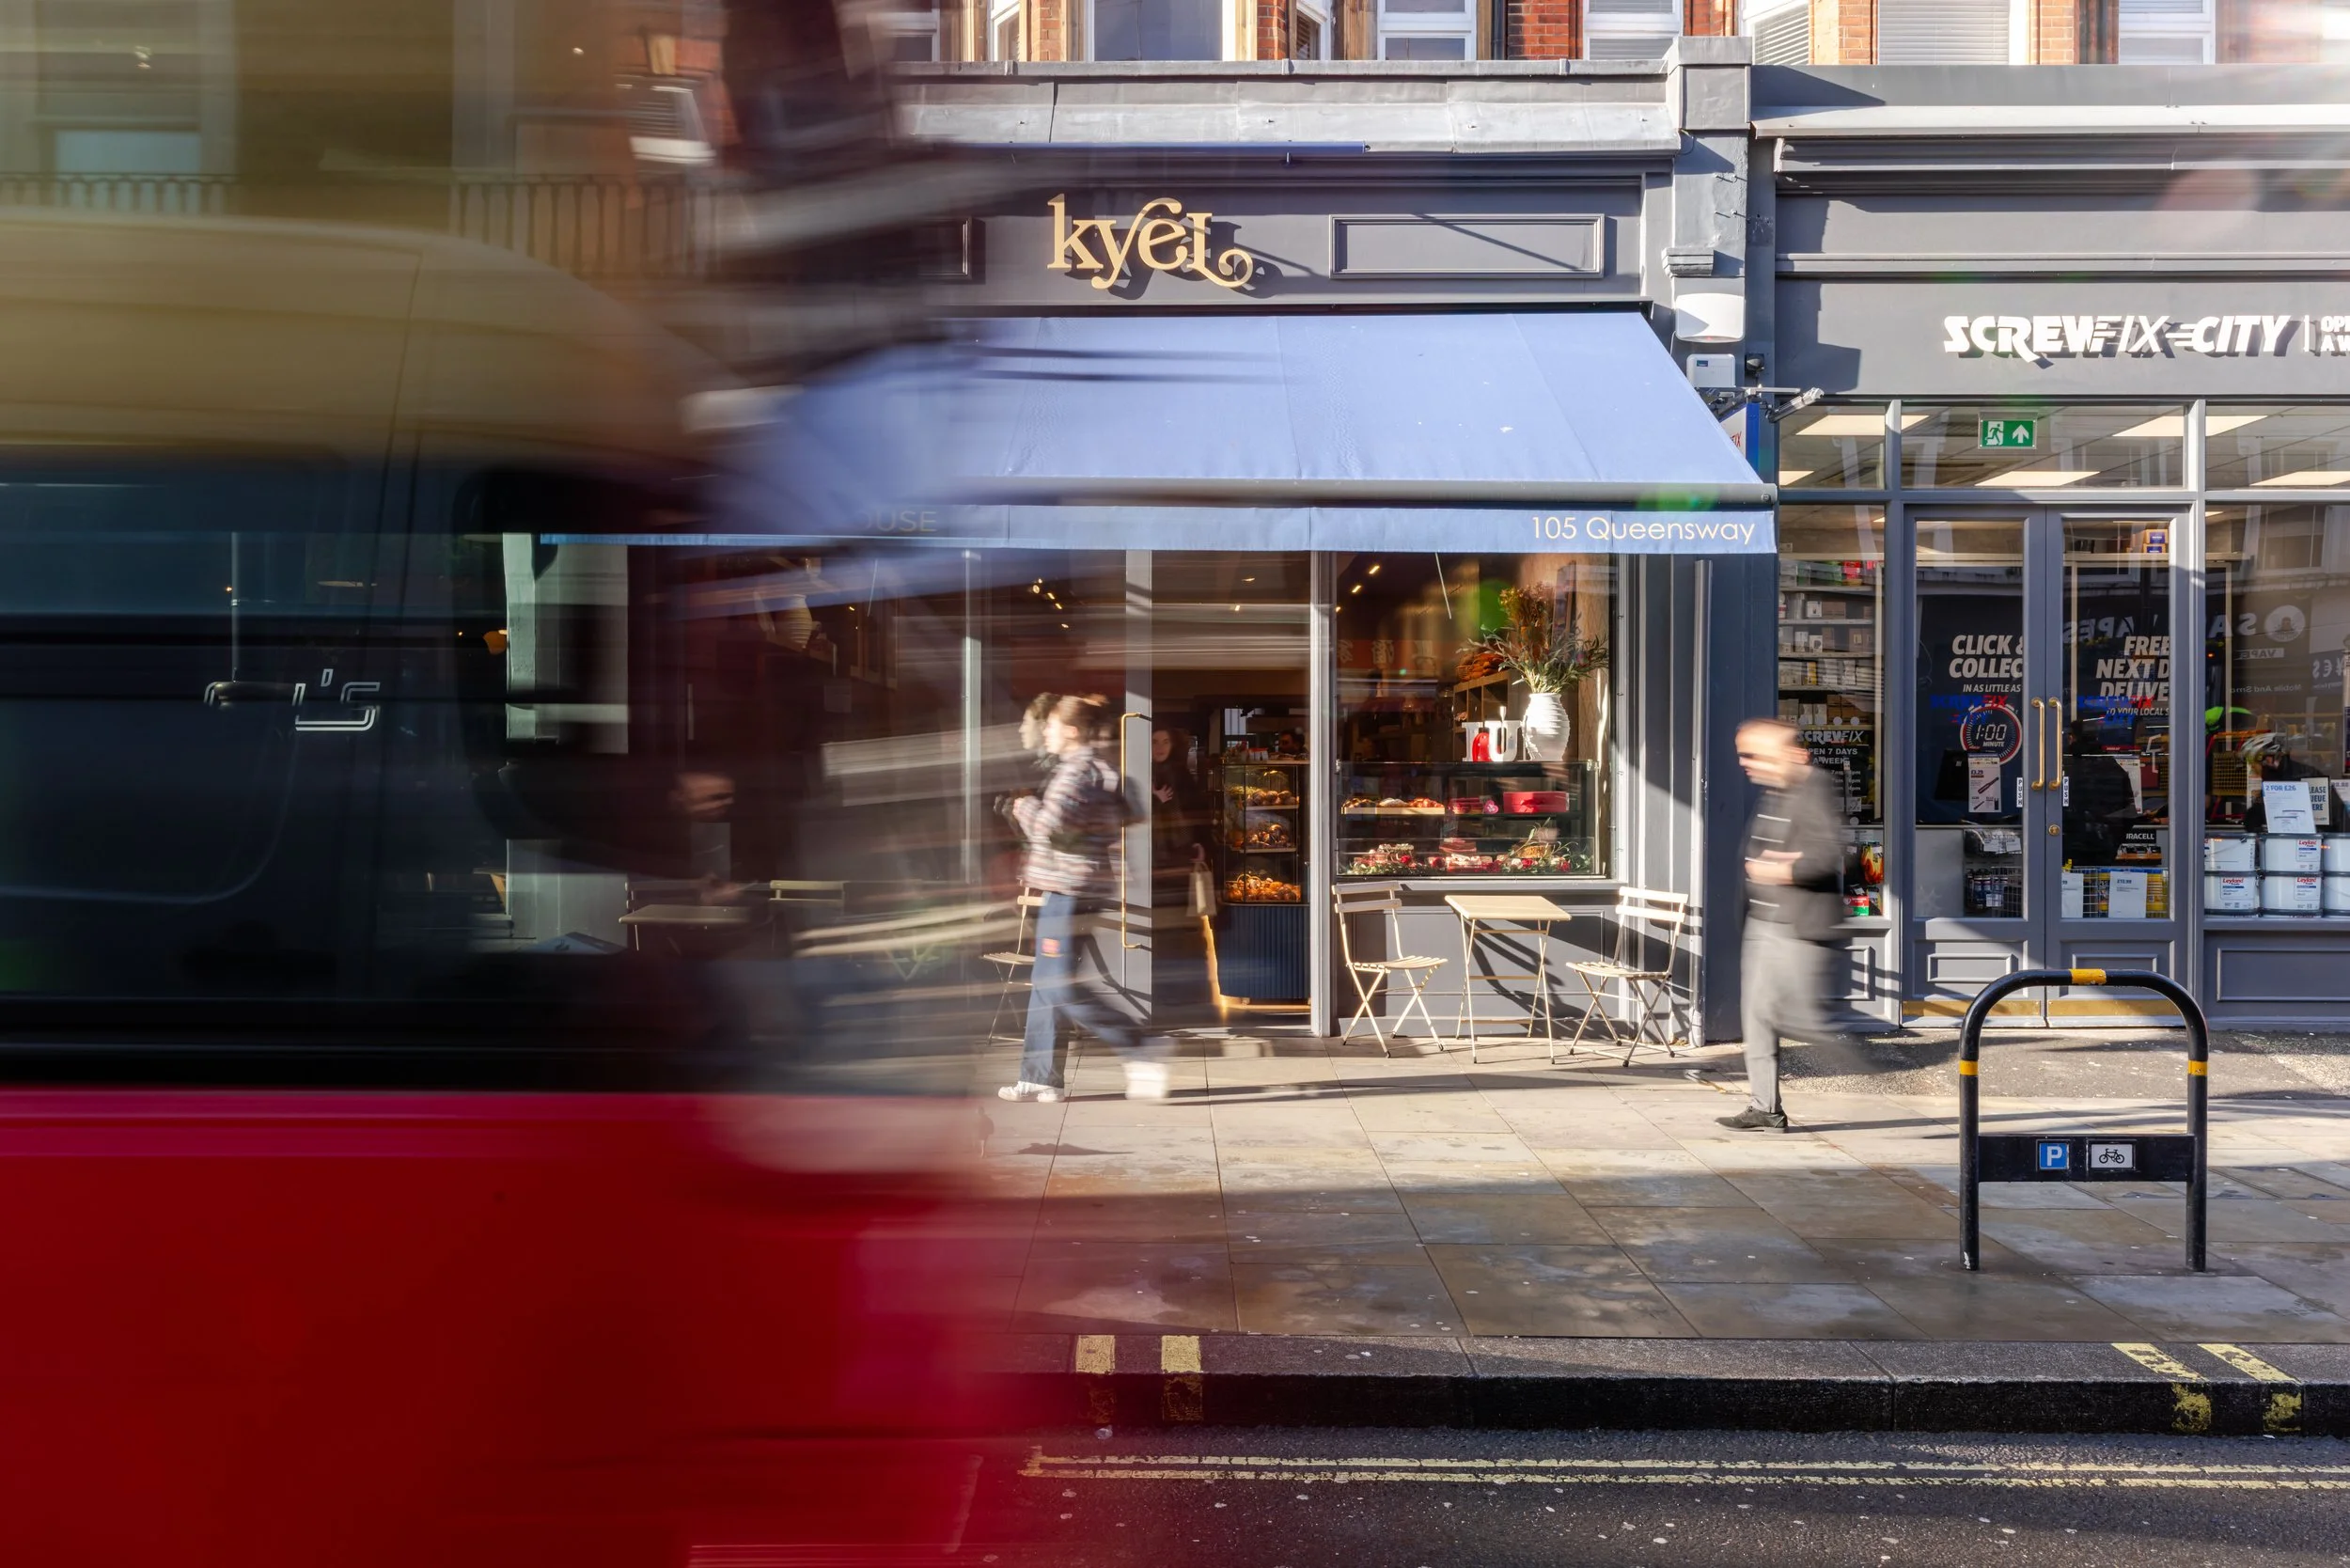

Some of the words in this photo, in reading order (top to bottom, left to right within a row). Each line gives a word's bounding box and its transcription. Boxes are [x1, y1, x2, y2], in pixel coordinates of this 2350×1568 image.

[1944, 315, 2170, 363] SCREWFIX
[2187, 315, 2292, 353] CITY
[1532, 516, 1576, 540] 105
[1586, 516, 1755, 545] Queensway
[1951, 635, 2013, 655] CLICK
[2095, 658, 2154, 679] NEXT
[1963, 684, 1973, 693] IN
[1973, 684, 1984, 693] AS
[1984, 684, 2010, 693] LITTLE
[2010, 684, 2021, 693] AS
[2139, 707, 2162, 716] LOCAL
[1975, 724, 2007, 741] 1:00
[2046, 1146, 2063, 1167] P
